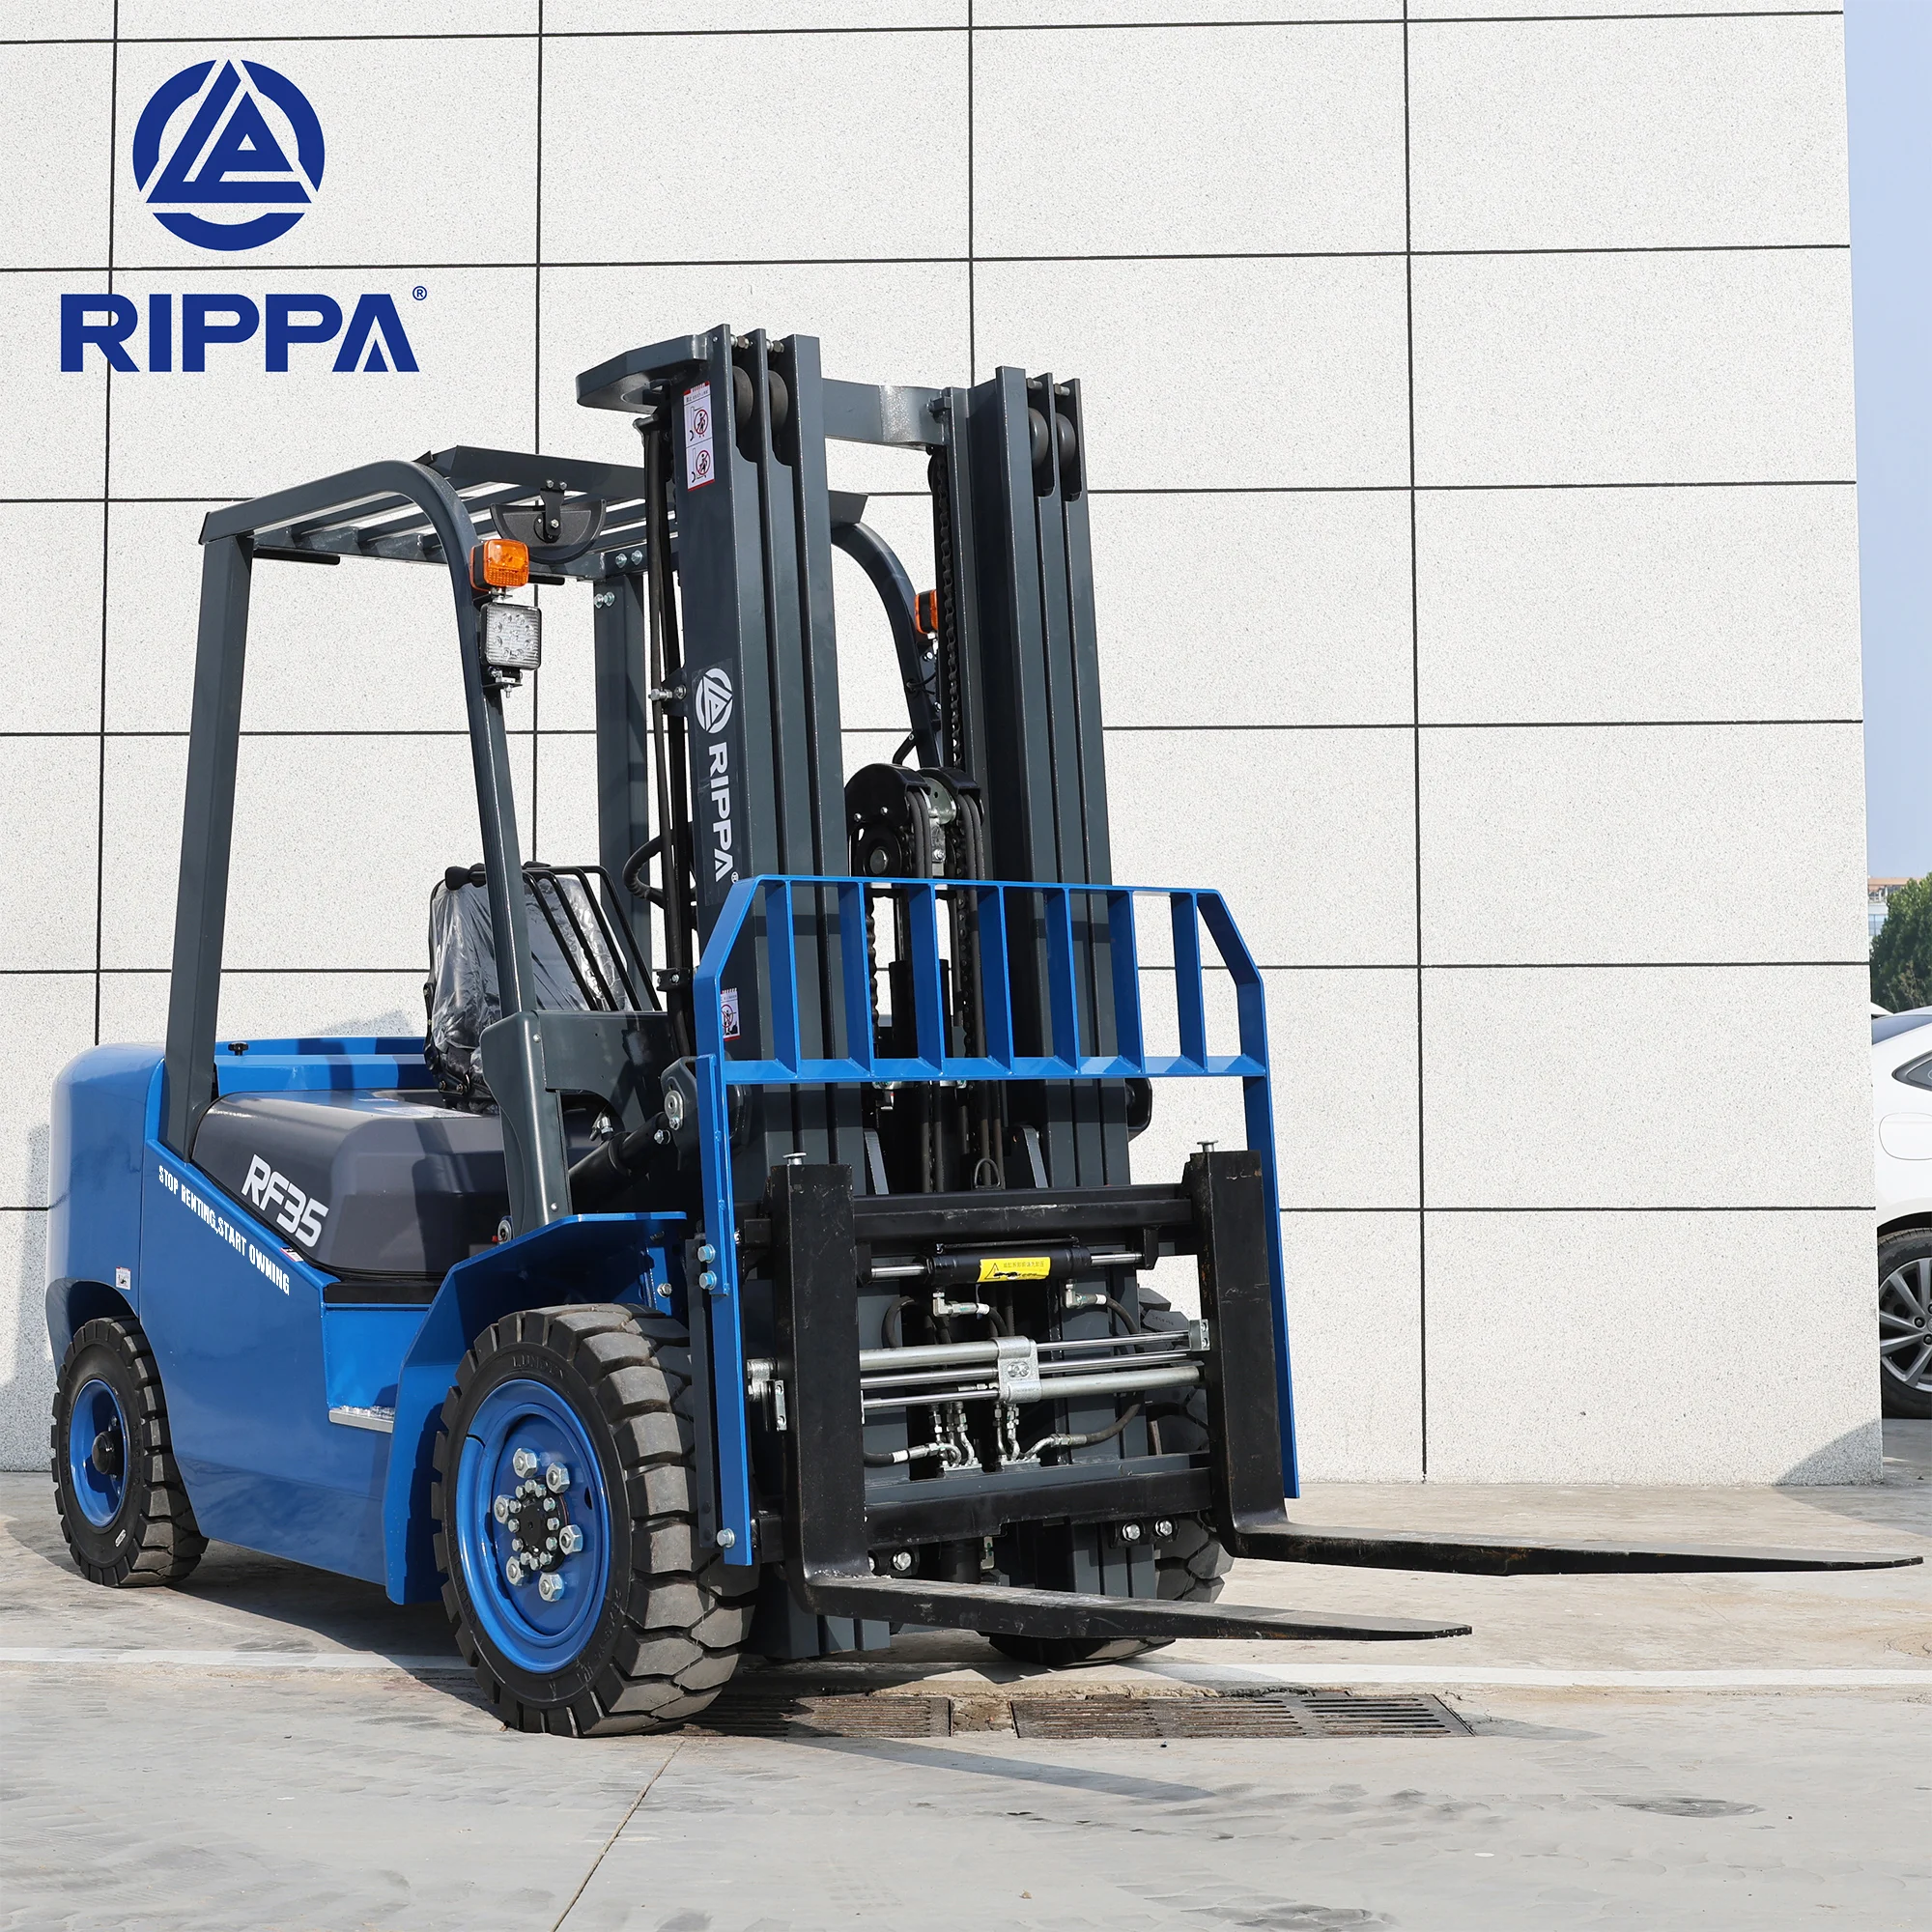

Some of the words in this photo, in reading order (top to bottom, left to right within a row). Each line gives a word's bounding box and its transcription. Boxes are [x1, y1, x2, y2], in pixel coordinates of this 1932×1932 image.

[158, 1165, 179, 1195] STOP
[248, 1243, 290, 1296] OWNING
[241, 1153, 328, 1247] RF35
